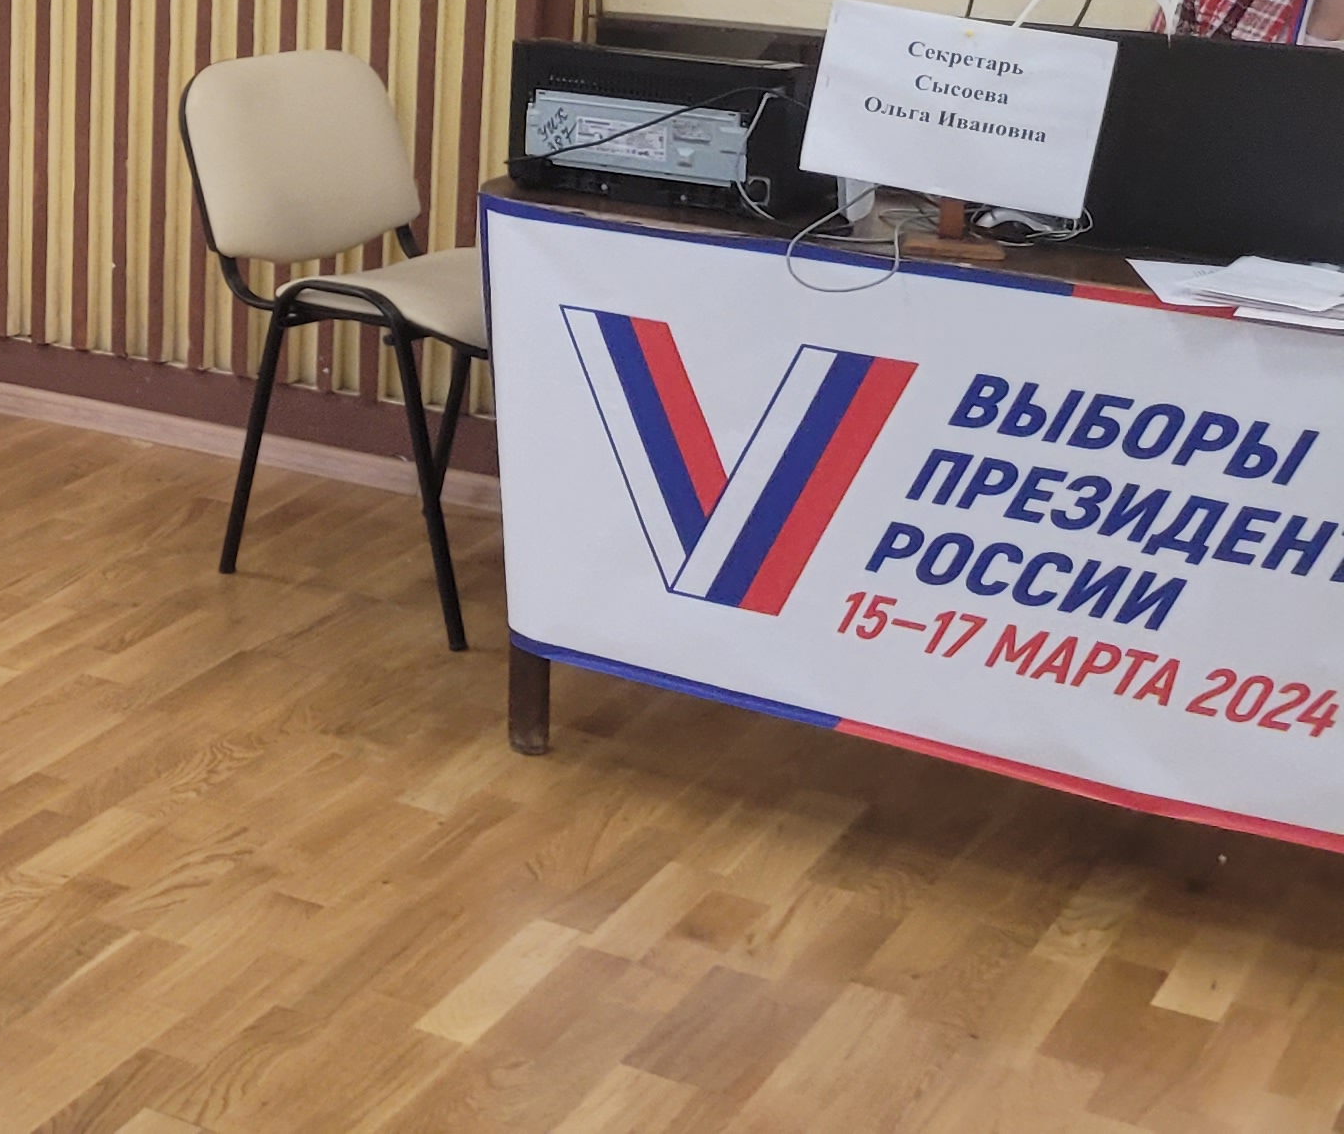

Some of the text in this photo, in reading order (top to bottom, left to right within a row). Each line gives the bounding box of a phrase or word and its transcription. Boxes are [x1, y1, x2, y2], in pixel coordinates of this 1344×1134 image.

[908, 41, 1024, 75] Секретарь
[915, 74, 1009, 104] Сысоева
[864, 95, 1047, 143] Ольга Ивановна
[948, 372, 1320, 487] ВЫБОРЫ
[865, 522, 1188, 632] РОССИИ
[988, 631, 1181, 706] МАРТА
[1186, 667, 1339, 740] 2024
